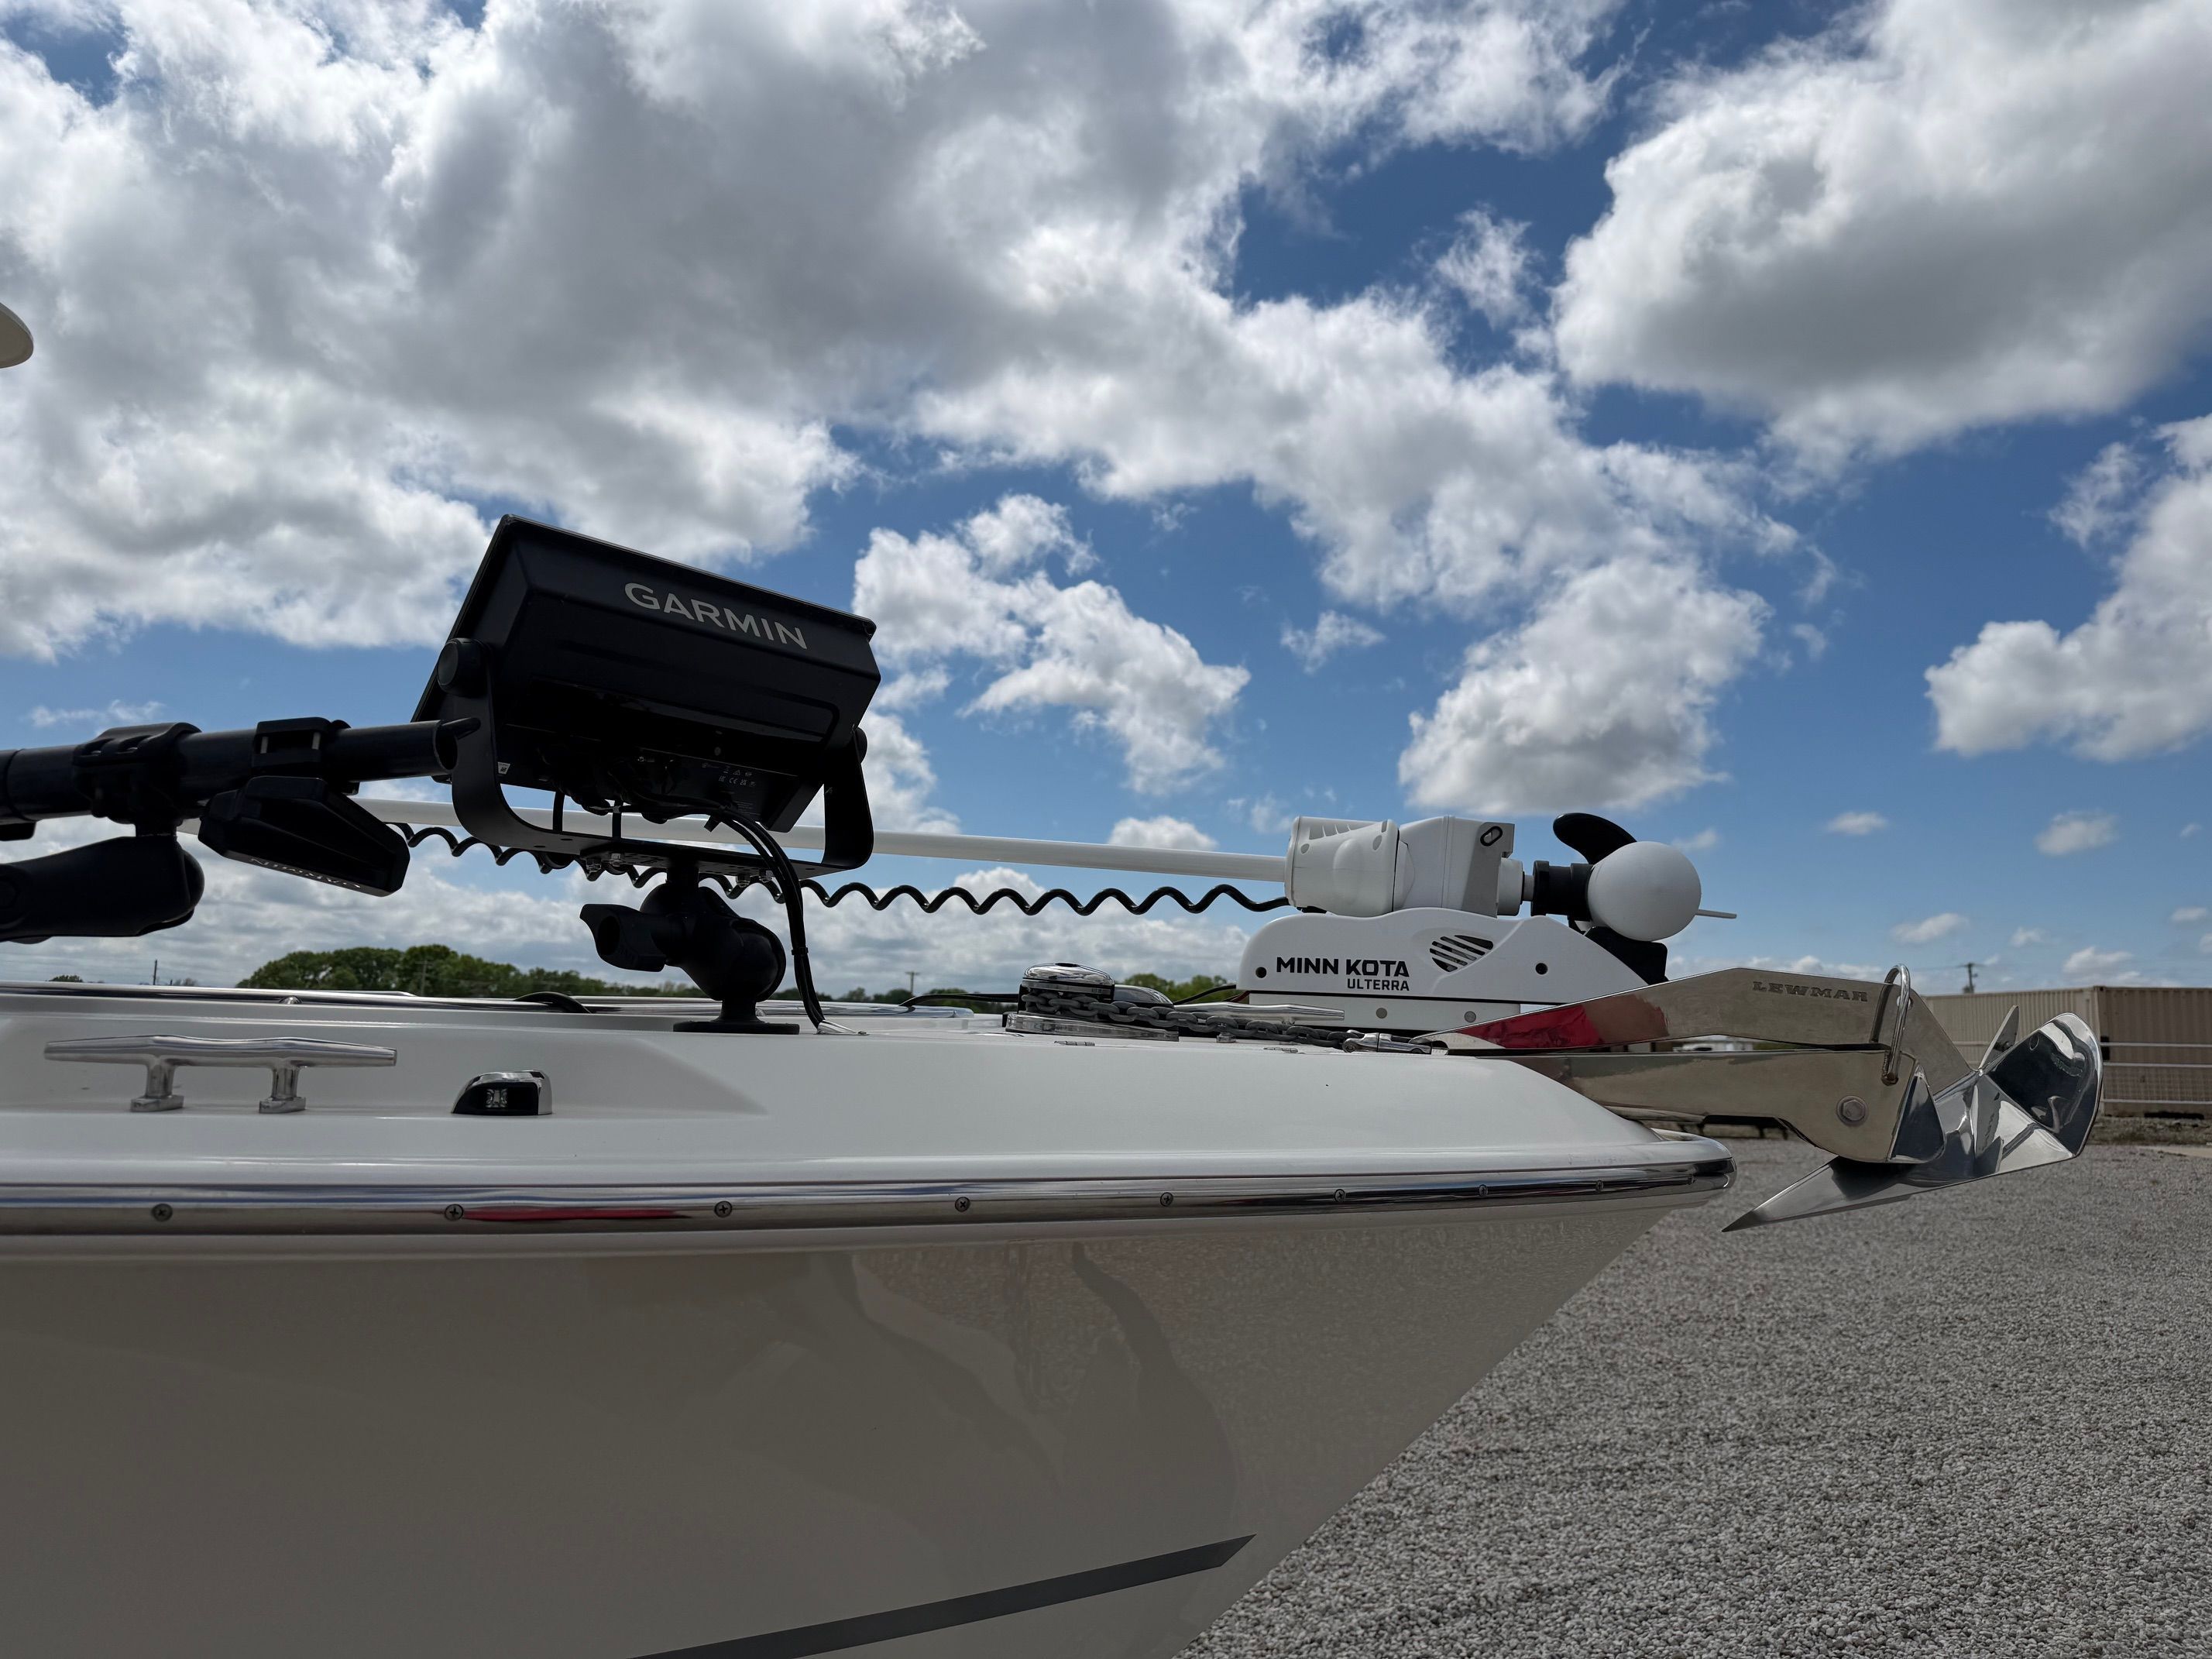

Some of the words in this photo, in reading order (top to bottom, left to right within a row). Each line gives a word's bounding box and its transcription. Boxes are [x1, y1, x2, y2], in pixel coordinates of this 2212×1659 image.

[624, 582, 807, 650] GARMIN
[1276, 957, 1339, 974] MINN
[1346, 959, 1410, 977] KOTA
[1347, 978, 1410, 991] ULTERRA
[1753, 981, 1868, 1002] LEWMAR
